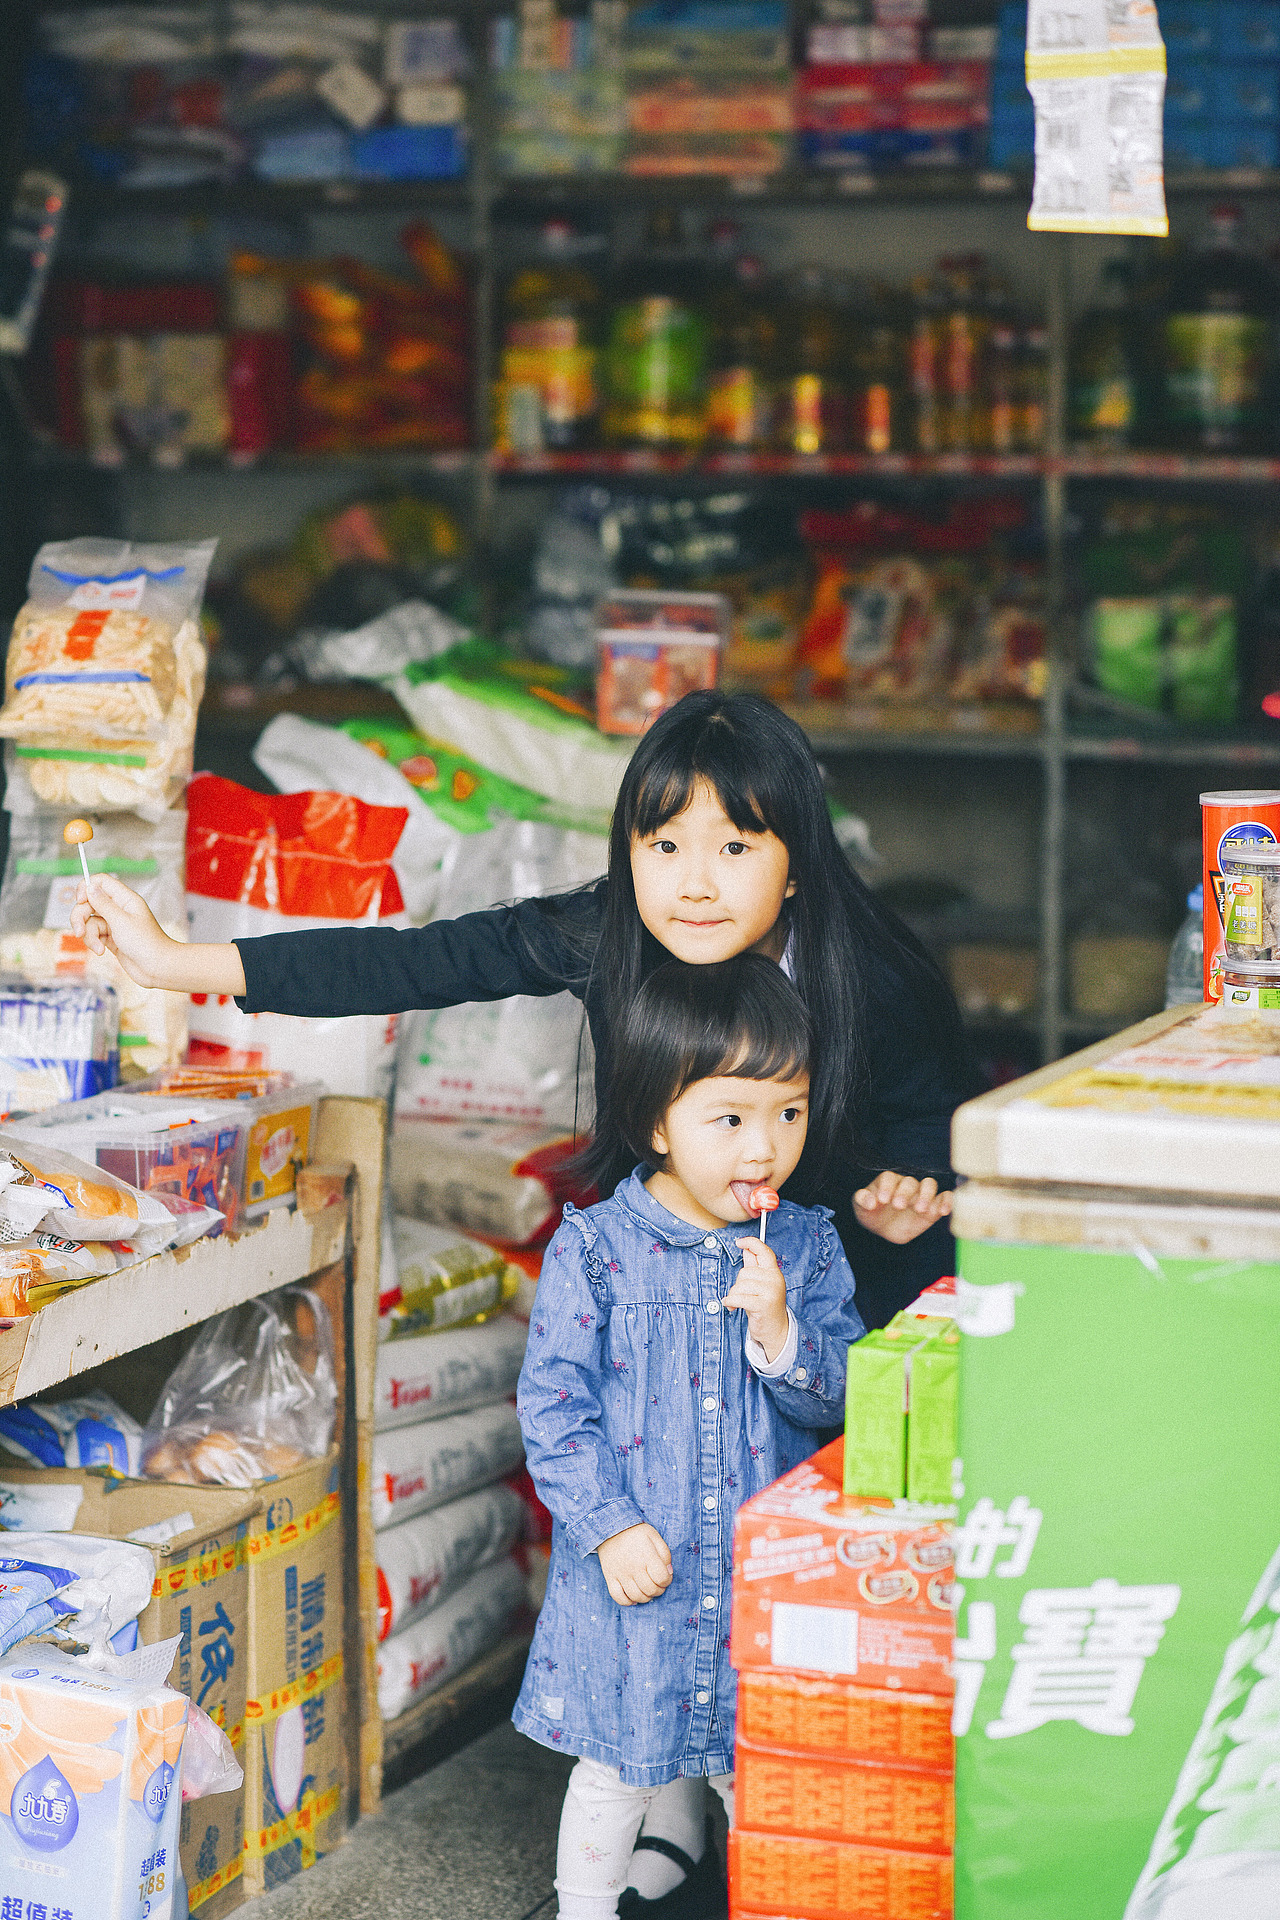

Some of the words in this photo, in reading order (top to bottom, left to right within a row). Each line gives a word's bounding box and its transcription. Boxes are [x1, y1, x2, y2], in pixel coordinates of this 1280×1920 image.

[953, 1496, 1043, 1578] 的
[19, 1792, 69, 1825] 九九香
